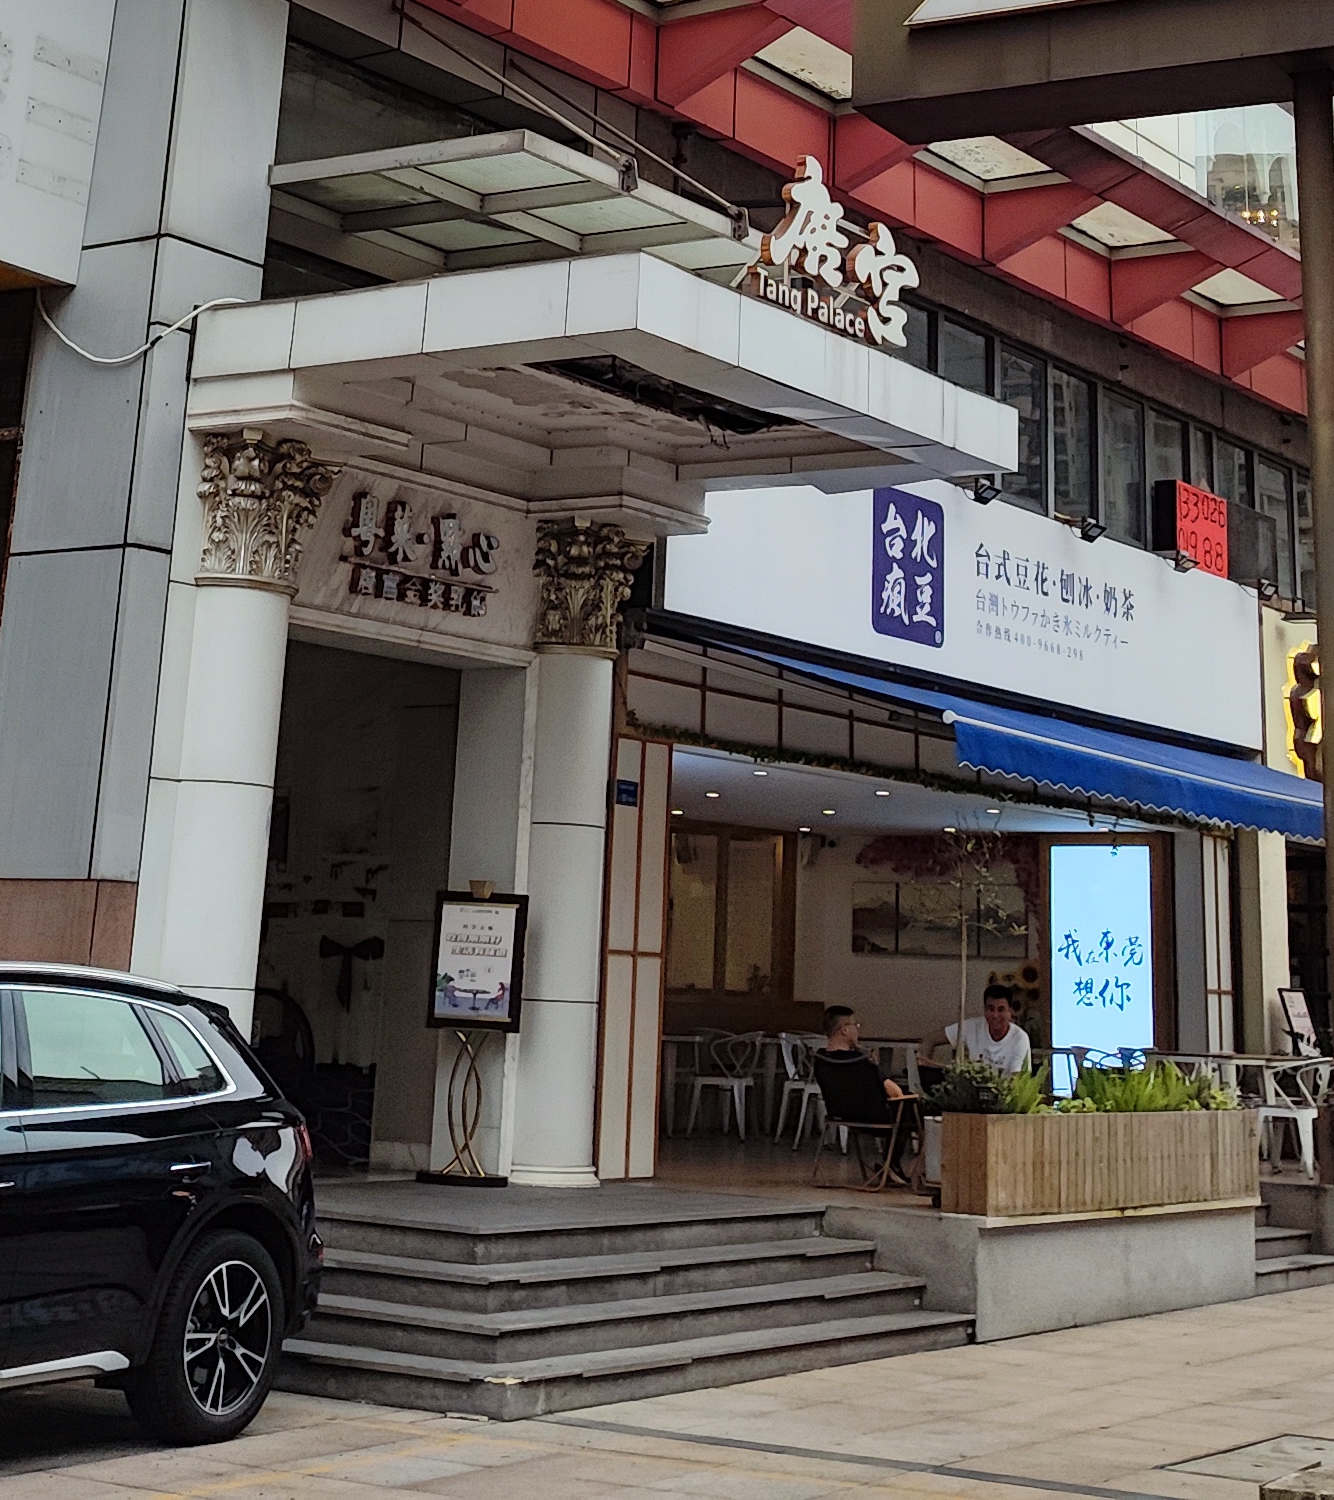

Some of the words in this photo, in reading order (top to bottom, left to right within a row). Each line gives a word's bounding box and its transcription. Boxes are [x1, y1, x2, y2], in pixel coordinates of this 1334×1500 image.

[757, 266, 803, 315] Tang
[807, 288, 866, 338] Palace
[880, 502, 938, 569] 台北
[1072, 975, 1132, 1012] 想你
